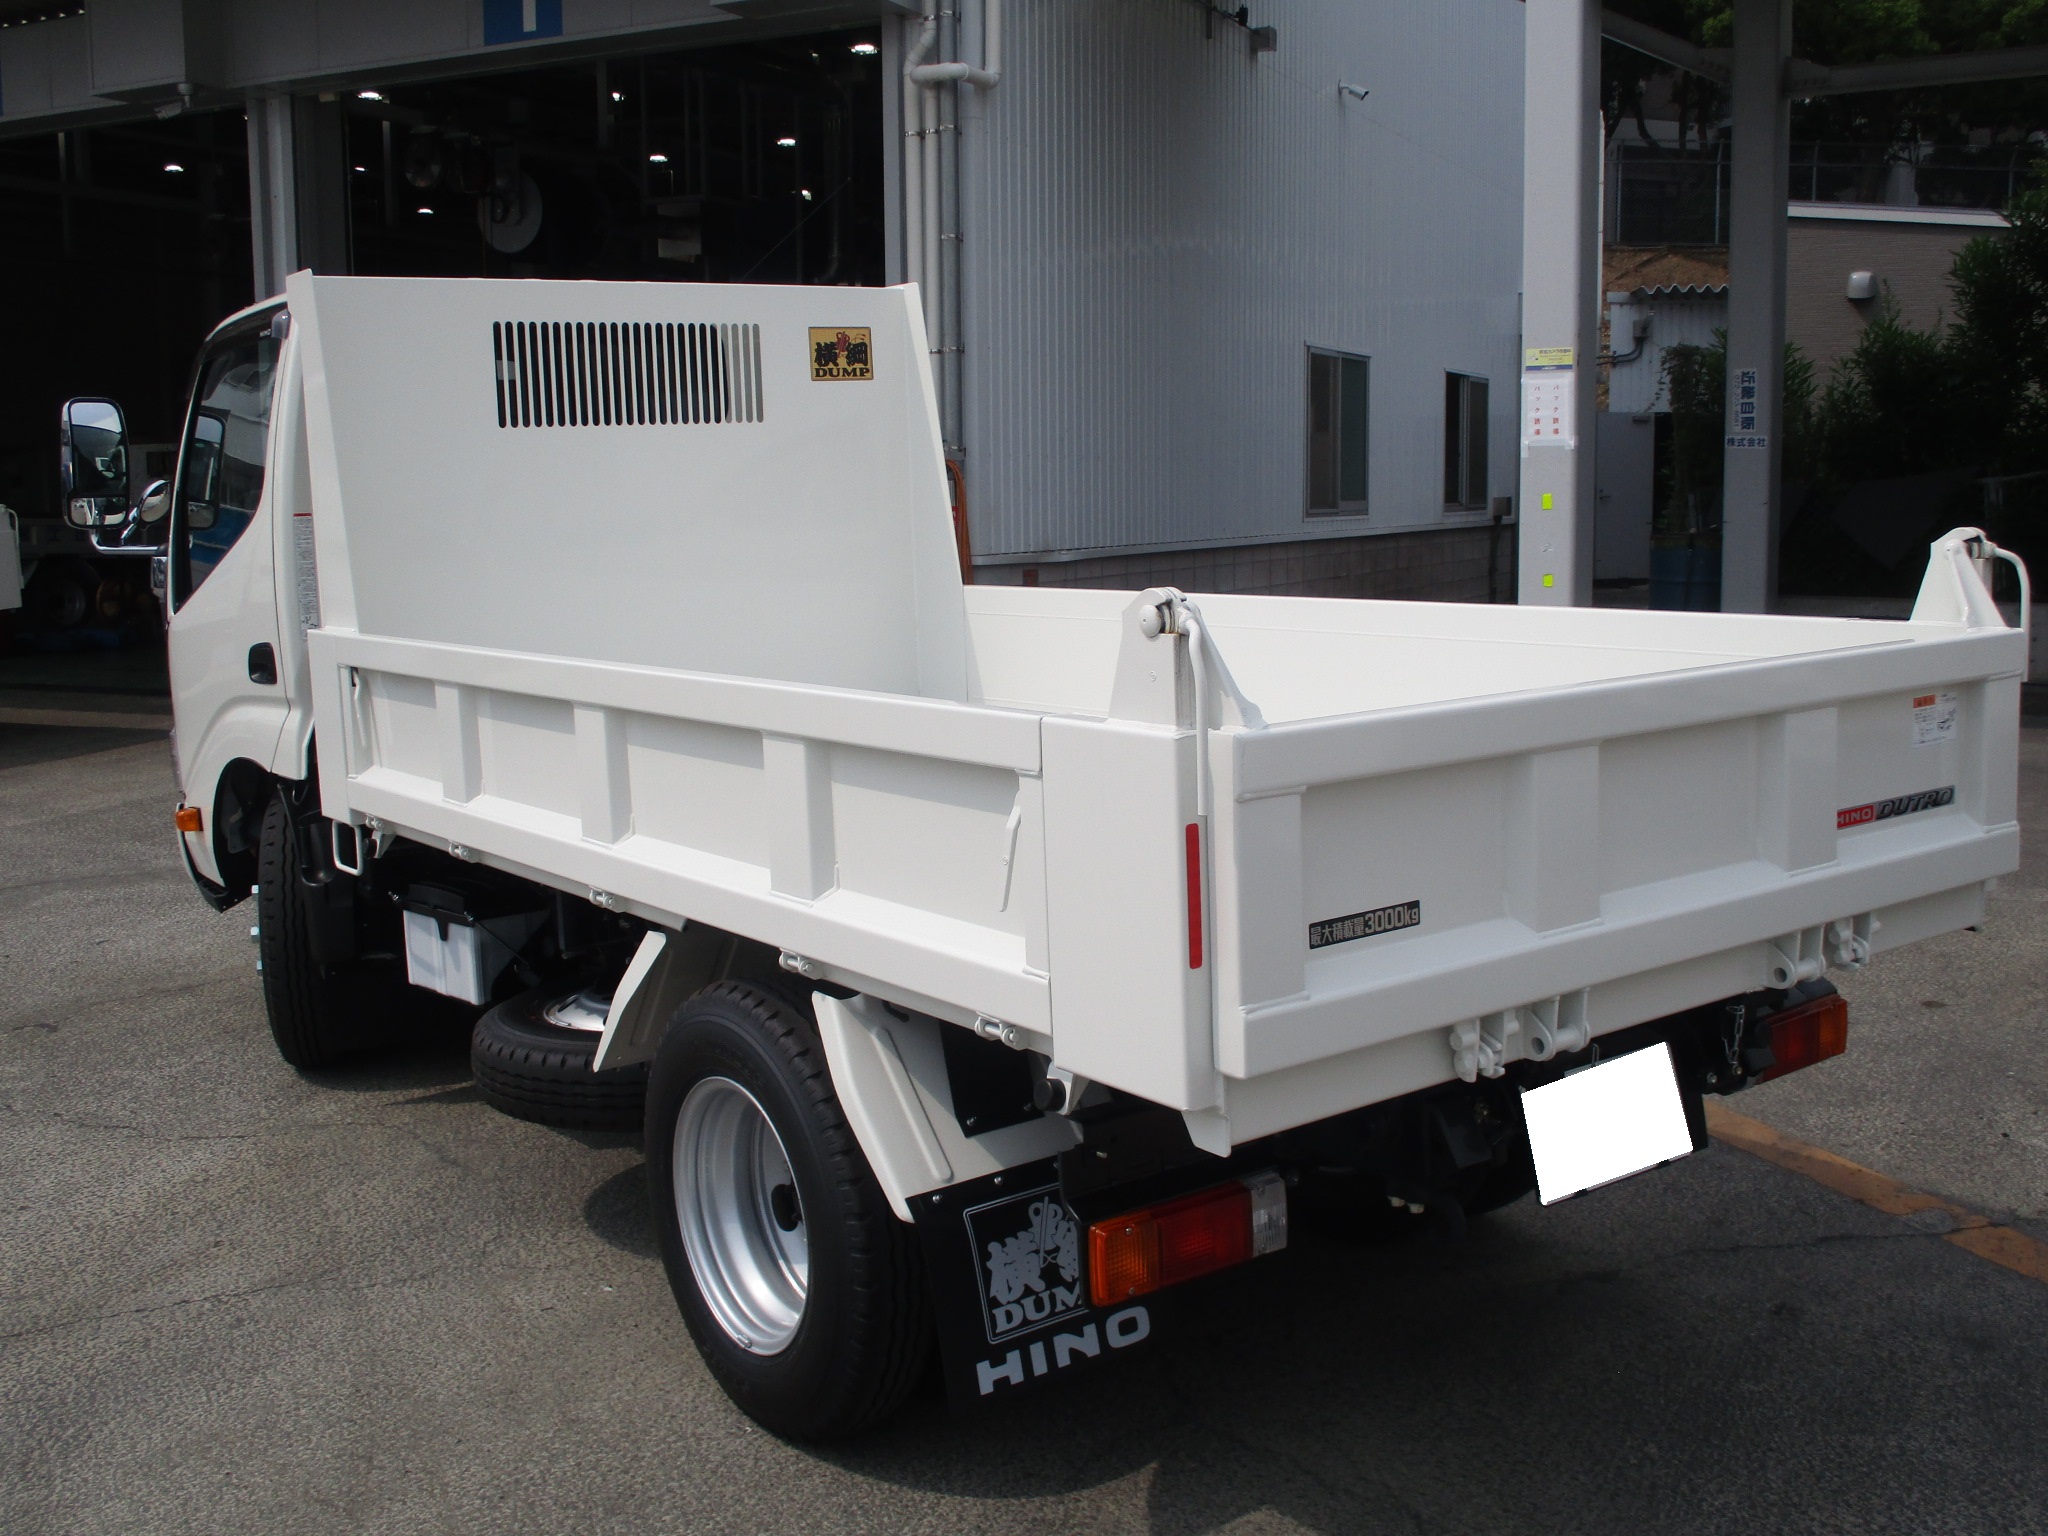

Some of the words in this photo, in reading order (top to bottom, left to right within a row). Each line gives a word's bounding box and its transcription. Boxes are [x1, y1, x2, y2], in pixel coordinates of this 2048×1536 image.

[814, 367, 870, 377] DUMP
[1741, 371, 1755, 430] 近畿自販
[1727, 437, 1766, 448] 株式会社
[1876, 786, 1953, 820] DUTRO
[992, 1285, 1083, 1334] DUM
[976, 1306, 1151, 1396] HINO
